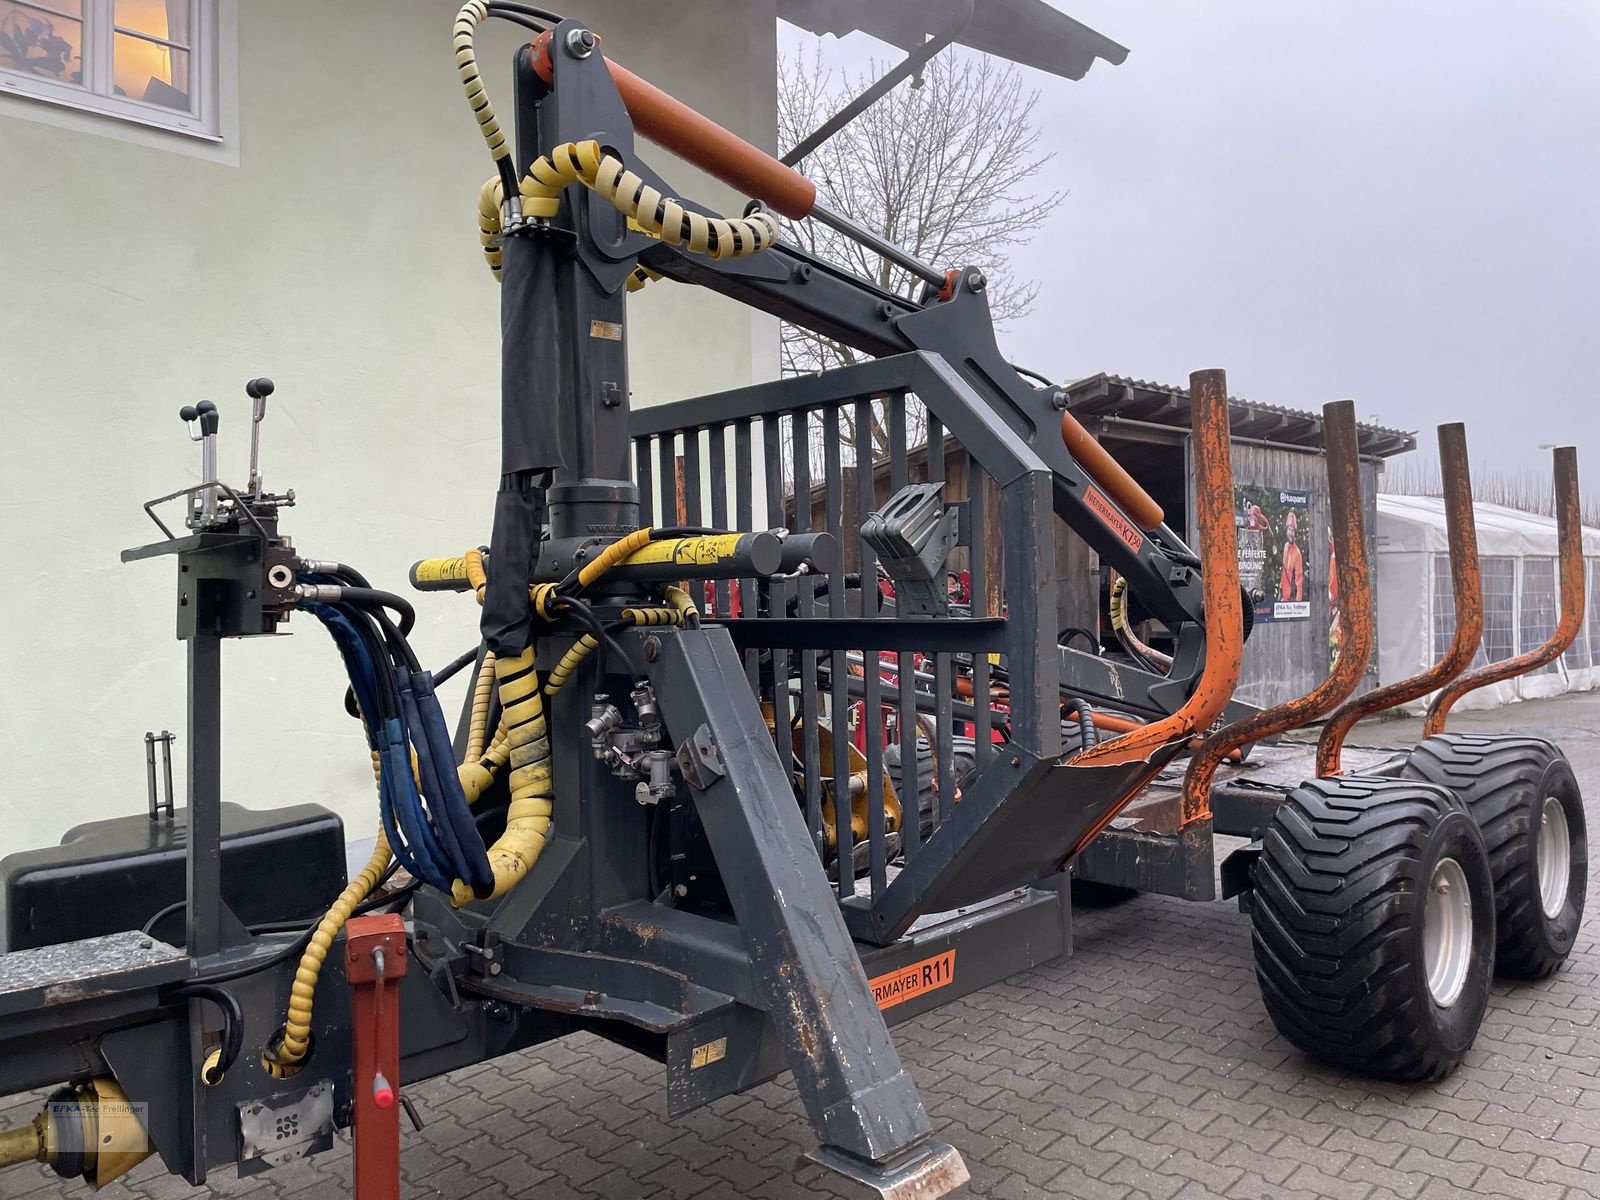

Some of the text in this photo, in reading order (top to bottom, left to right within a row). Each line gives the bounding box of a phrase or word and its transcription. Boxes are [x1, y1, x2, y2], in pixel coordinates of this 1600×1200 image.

[1238, 561, 1265, 570] BINDUNG"
[872, 957, 950, 1001] RMAYER R11
